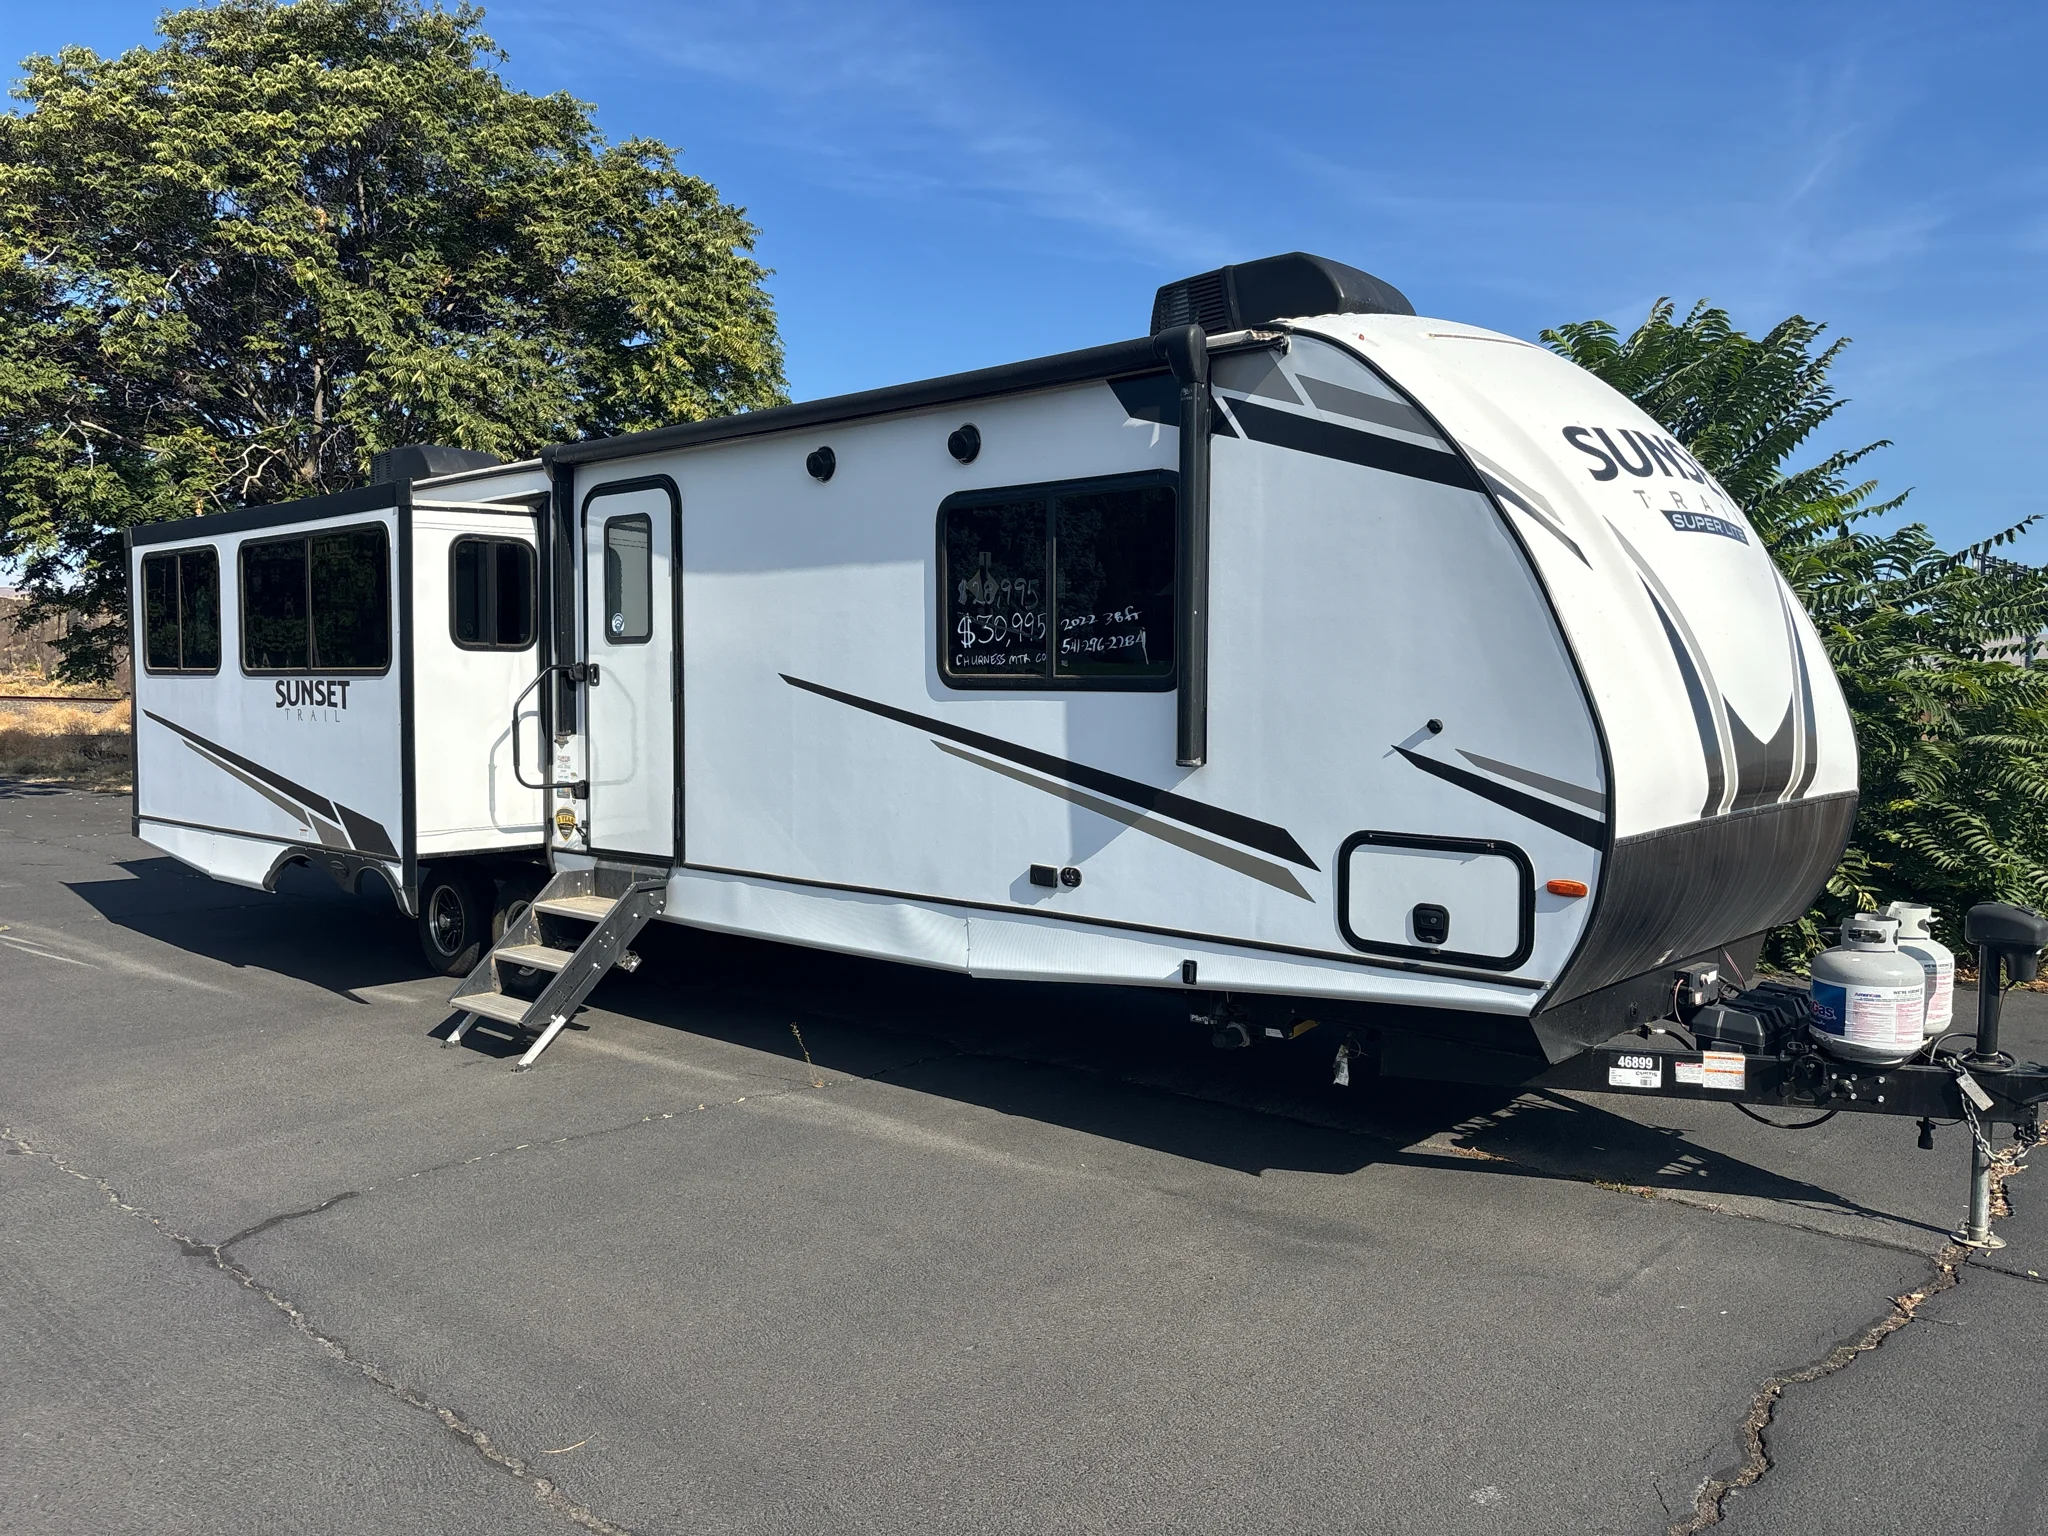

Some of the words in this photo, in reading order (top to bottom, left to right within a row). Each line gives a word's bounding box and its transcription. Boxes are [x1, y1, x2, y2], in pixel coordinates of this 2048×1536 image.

[1633, 489, 1746, 530] TRAIL
[1672, 513, 1723, 533] SUPER
[1722, 522, 1746, 541] LITE
[957, 612, 1047, 649] $30,995
[1060, 614, 1098, 632] 2022
[275, 680, 350, 710] SUNSET
[285, 708, 341, 722] TRAIL
[1617, 1055, 1653, 1069] 46899
